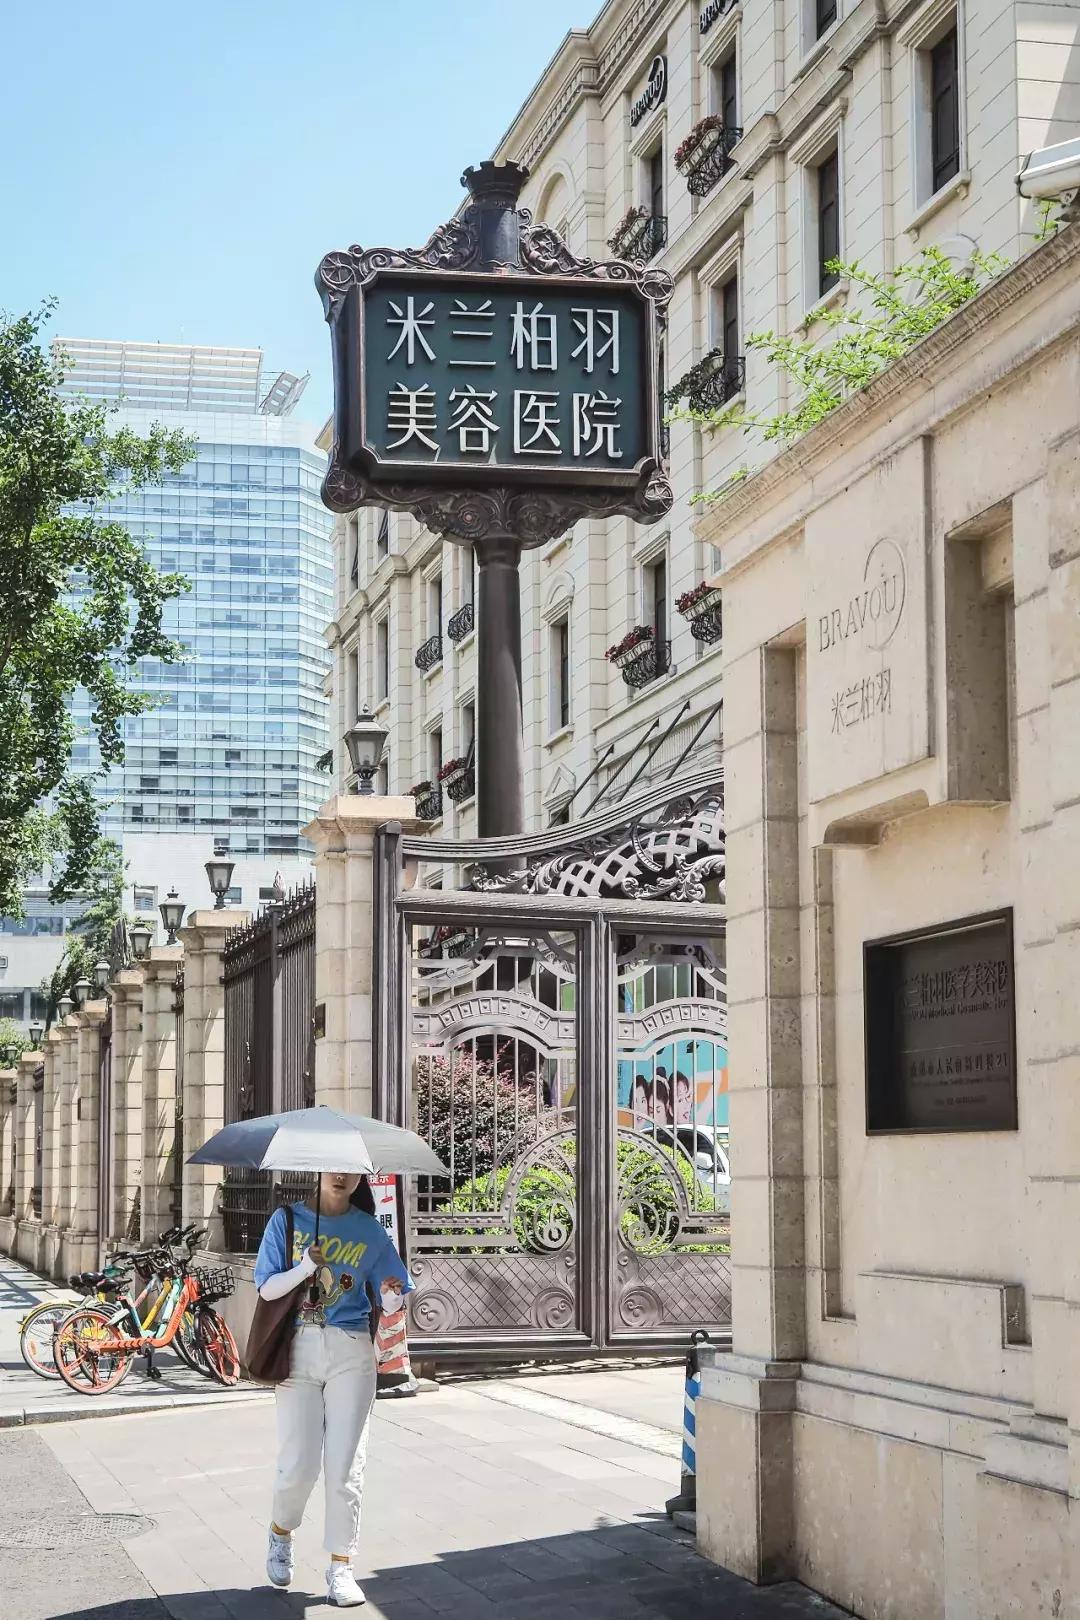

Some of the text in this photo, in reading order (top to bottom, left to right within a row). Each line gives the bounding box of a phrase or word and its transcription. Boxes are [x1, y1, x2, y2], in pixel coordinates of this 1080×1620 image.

[386, 296, 620, 374] 米兰柏羽
[386, 382, 623, 458] 美容医院
[819, 575, 896, 652] BRAVOU
[831, 668, 892, 735] 米兰柏羽
